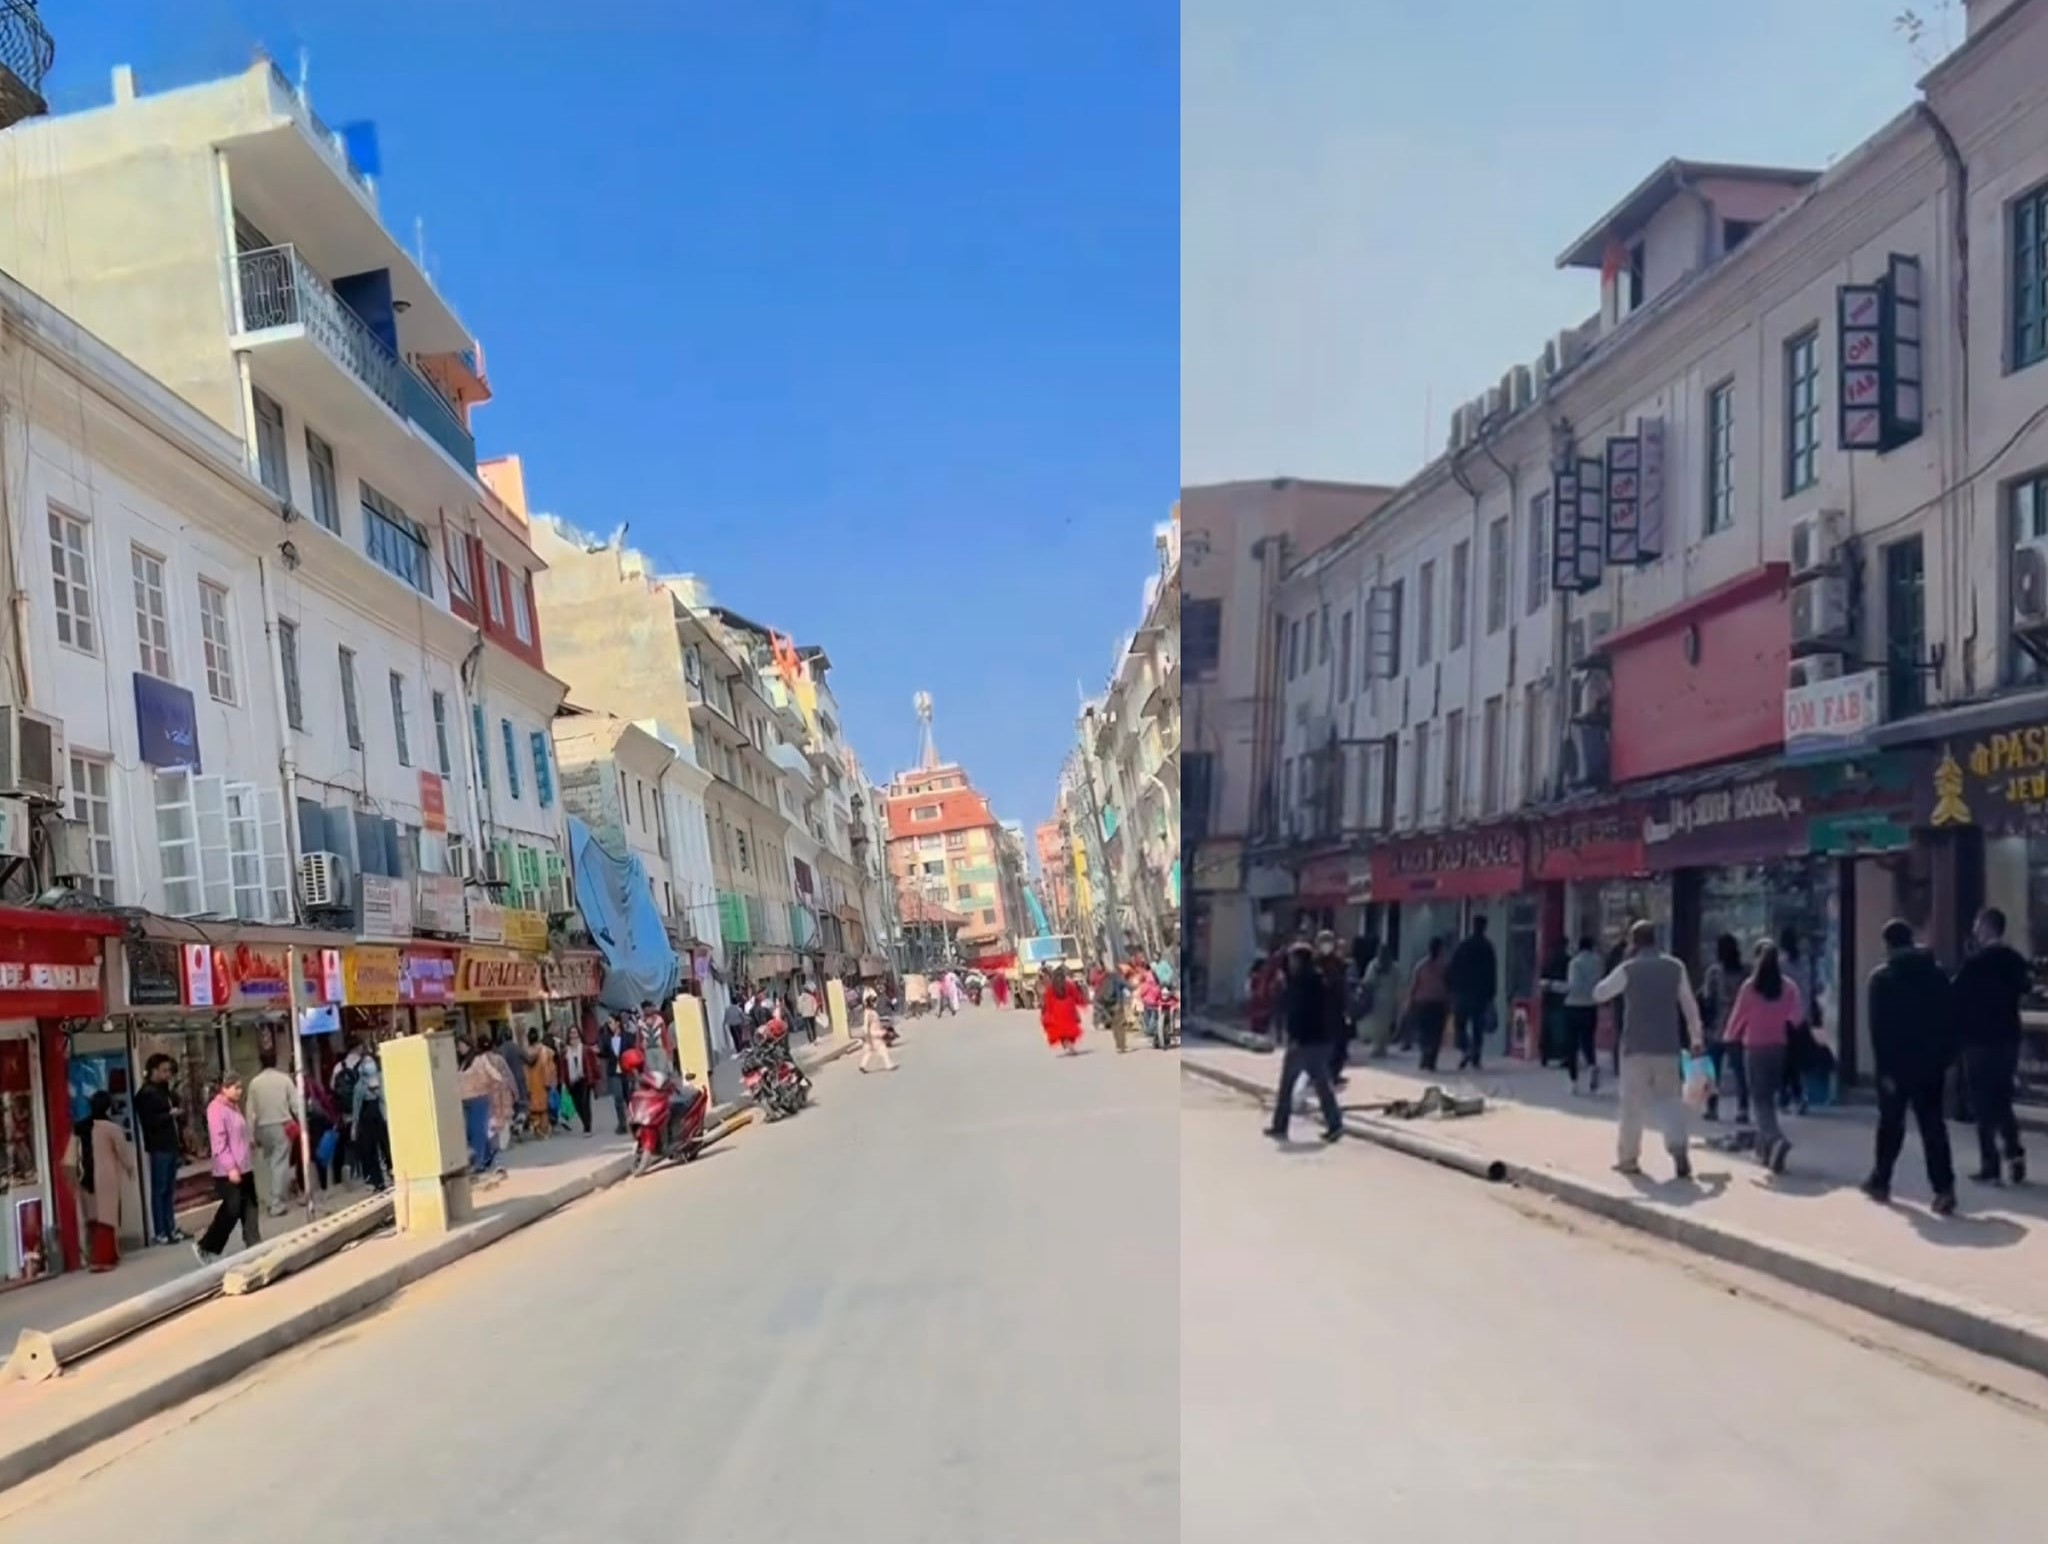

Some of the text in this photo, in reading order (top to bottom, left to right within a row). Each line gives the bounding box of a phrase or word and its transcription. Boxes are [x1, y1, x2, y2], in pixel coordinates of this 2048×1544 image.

[1847, 335, 1873, 362] OM
[1788, 691, 1861, 731] OM FAB
